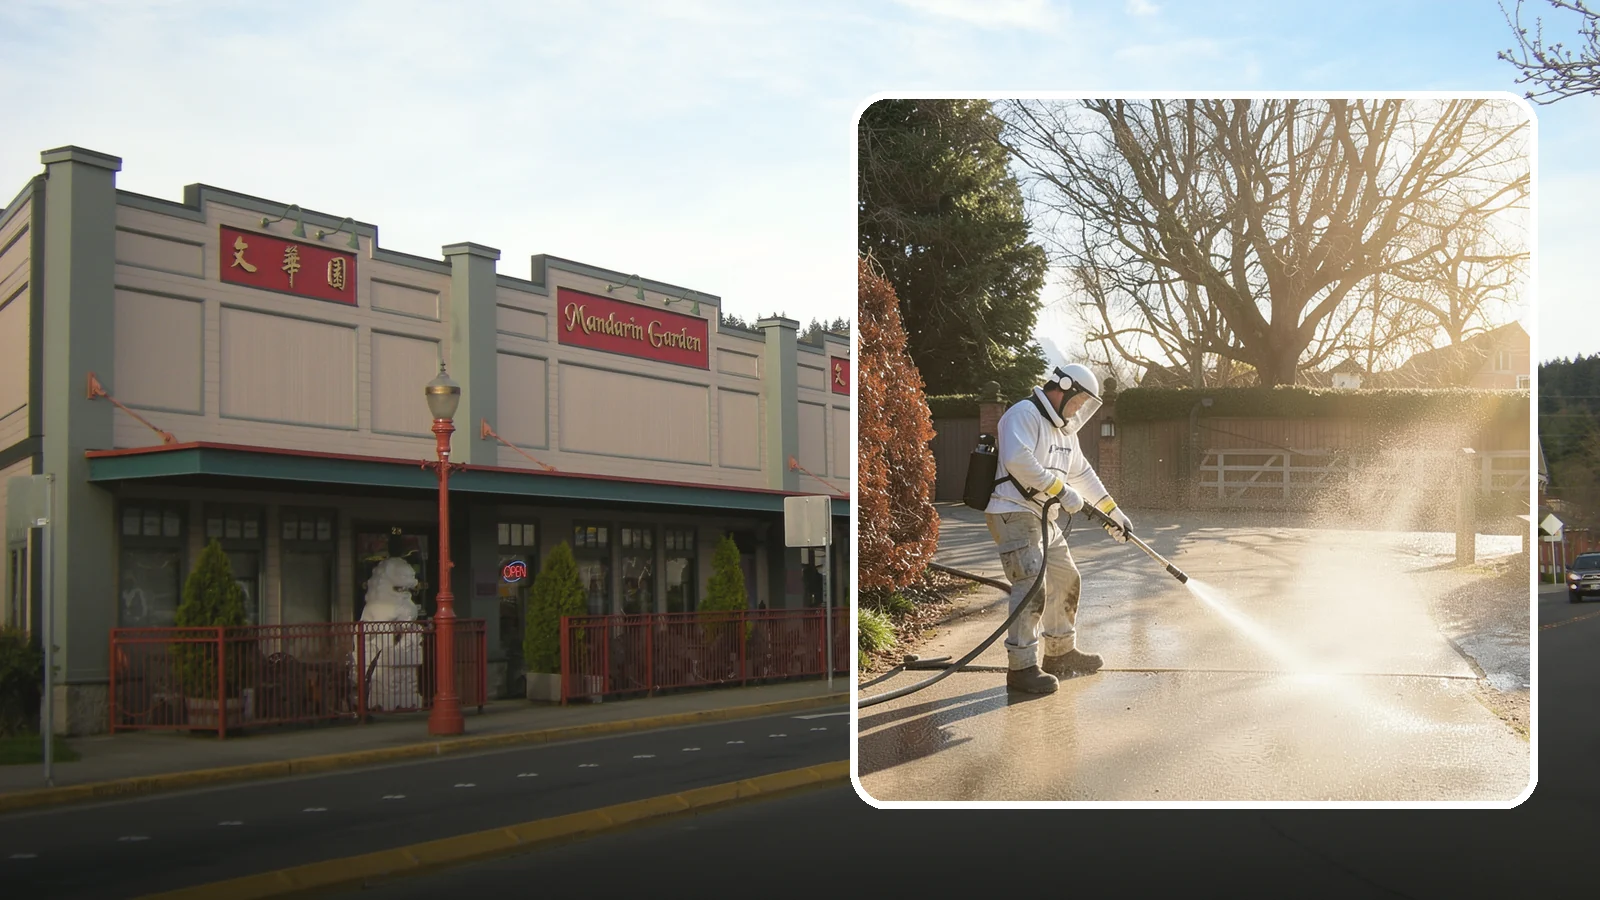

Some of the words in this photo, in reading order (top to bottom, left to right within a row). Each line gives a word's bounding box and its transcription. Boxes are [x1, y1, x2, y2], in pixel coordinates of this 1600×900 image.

[231, 236, 346, 291] 文華園
[564, 302, 643, 341] Mandarin
[648, 320, 701, 352] Garden
[503, 565, 527, 578] OPEN
